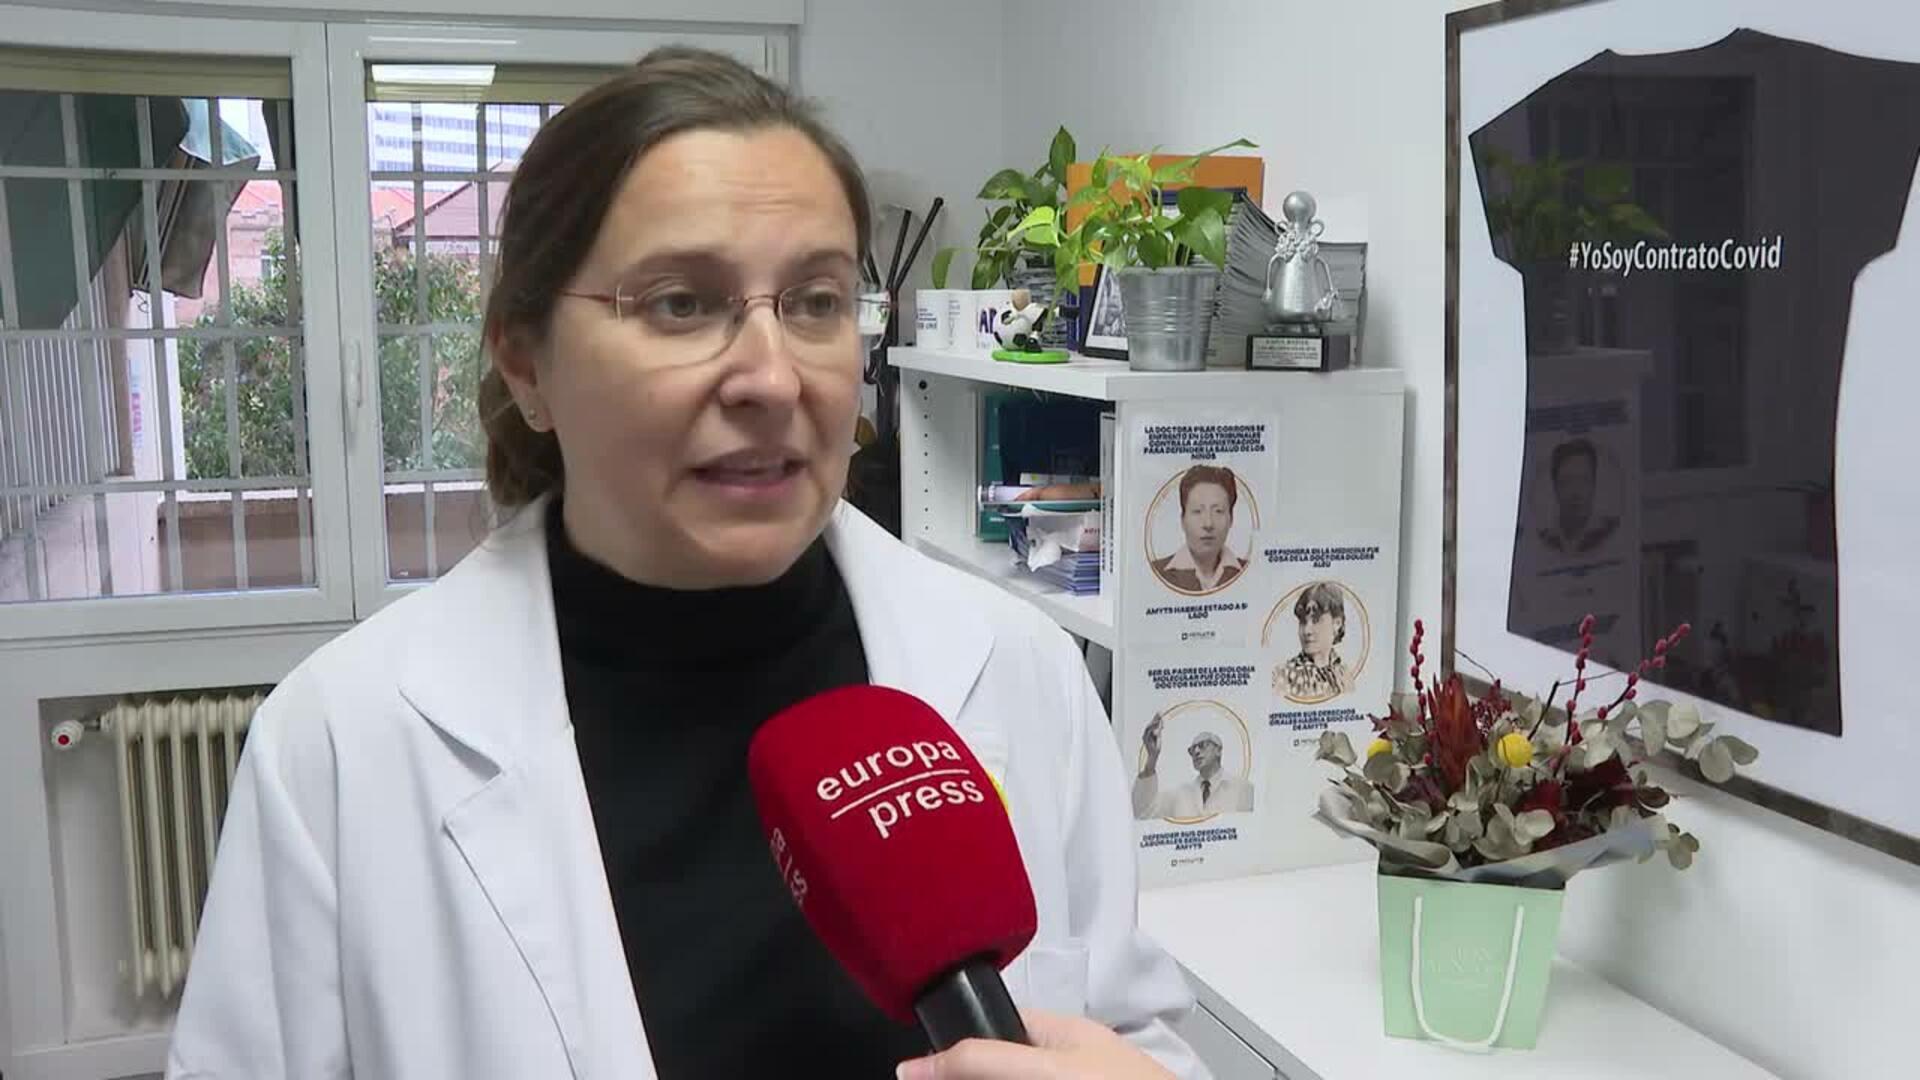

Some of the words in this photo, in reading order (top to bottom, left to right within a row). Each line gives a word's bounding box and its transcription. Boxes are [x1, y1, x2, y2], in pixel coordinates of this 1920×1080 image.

[1569, 234, 1783, 277] #YoSoyContratoCovid
[816, 740, 961, 801] europa
[868, 779, 985, 839] press
